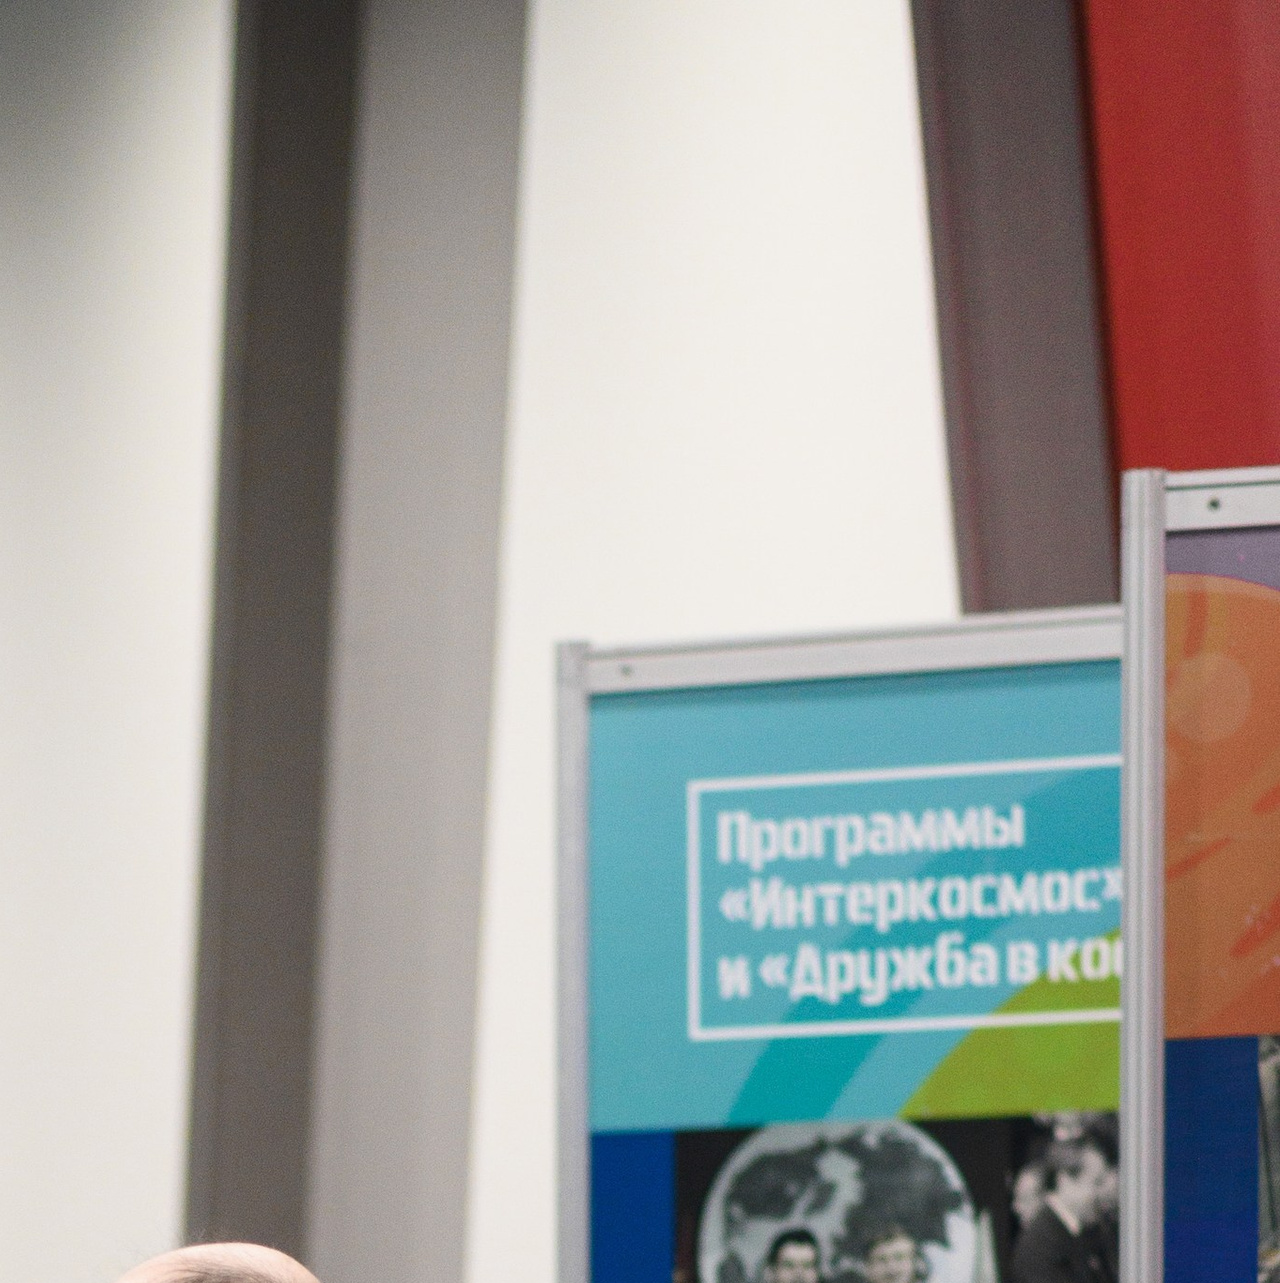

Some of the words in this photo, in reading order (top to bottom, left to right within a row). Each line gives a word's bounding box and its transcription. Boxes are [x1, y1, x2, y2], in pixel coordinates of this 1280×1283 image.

[717, 803, 1025, 872] Программы
[718, 955, 751, 999] и
[758, 931, 1000, 1006] «Дружба
[1006, 941, 1040, 983] в
